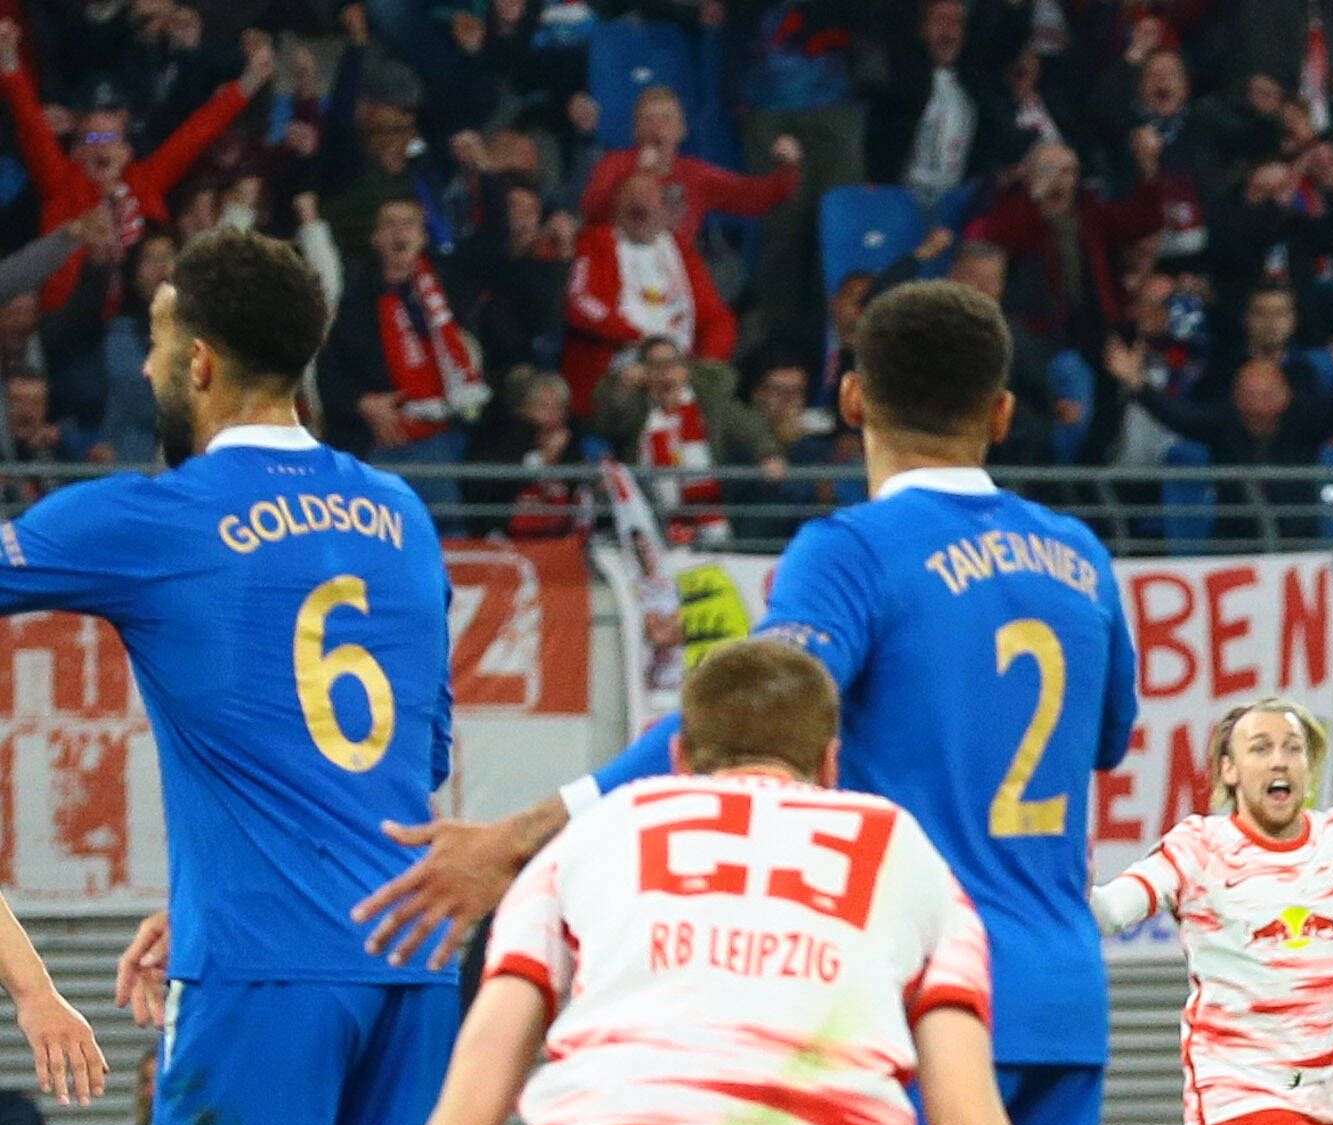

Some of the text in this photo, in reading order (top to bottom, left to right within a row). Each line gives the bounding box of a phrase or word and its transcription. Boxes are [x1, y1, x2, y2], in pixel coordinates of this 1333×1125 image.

[218, 493, 404, 554] GOLDSON
[924, 530, 1099, 602] TAVERNIER
[293, 574, 395, 773] 6
[1130, 564, 1332, 698] BEN
[989, 618, 1068, 838] 2
[632, 789, 898, 931] 23
[650, 920, 842, 984] RB LEIPZIG
